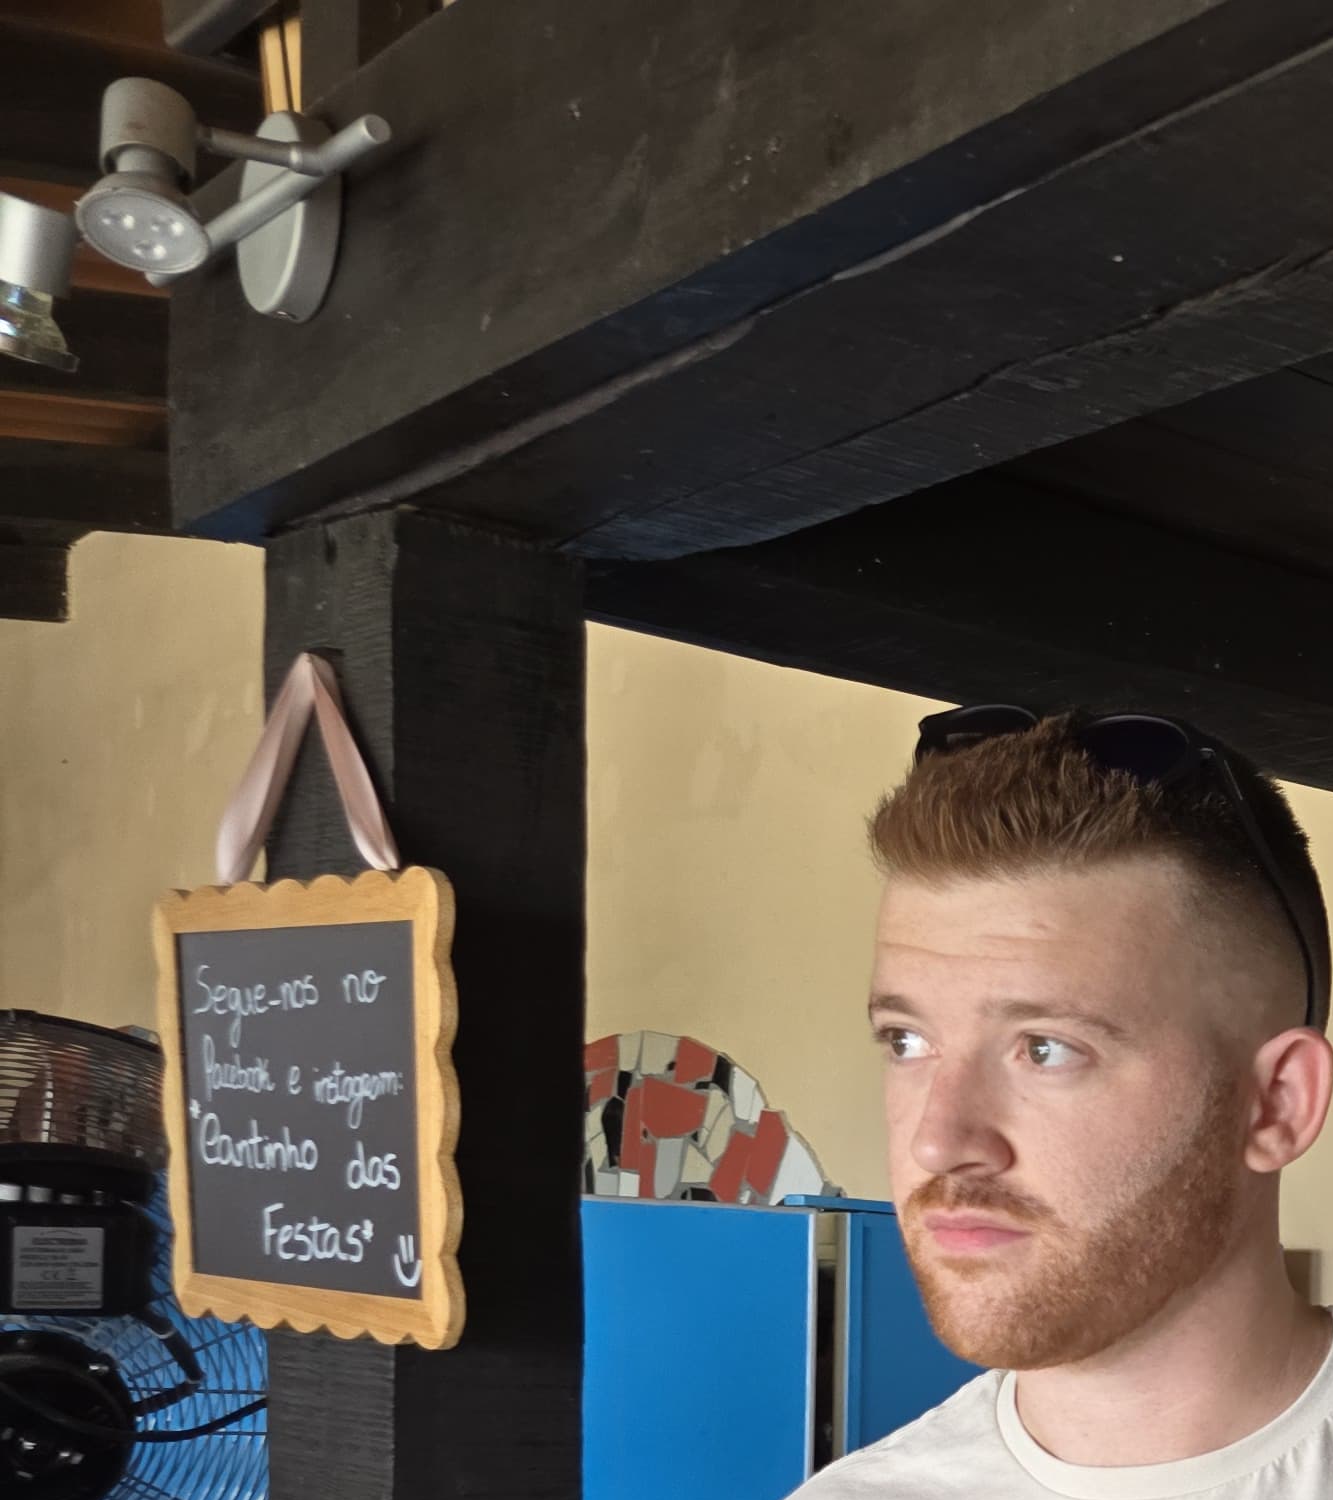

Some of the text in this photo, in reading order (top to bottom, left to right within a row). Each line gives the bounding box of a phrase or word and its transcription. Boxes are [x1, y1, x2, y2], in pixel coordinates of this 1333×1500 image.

[193, 965, 388, 1048] Segue-nos no
[286, 1065, 303, 1095] e
[347, 1140, 401, 1190] das
